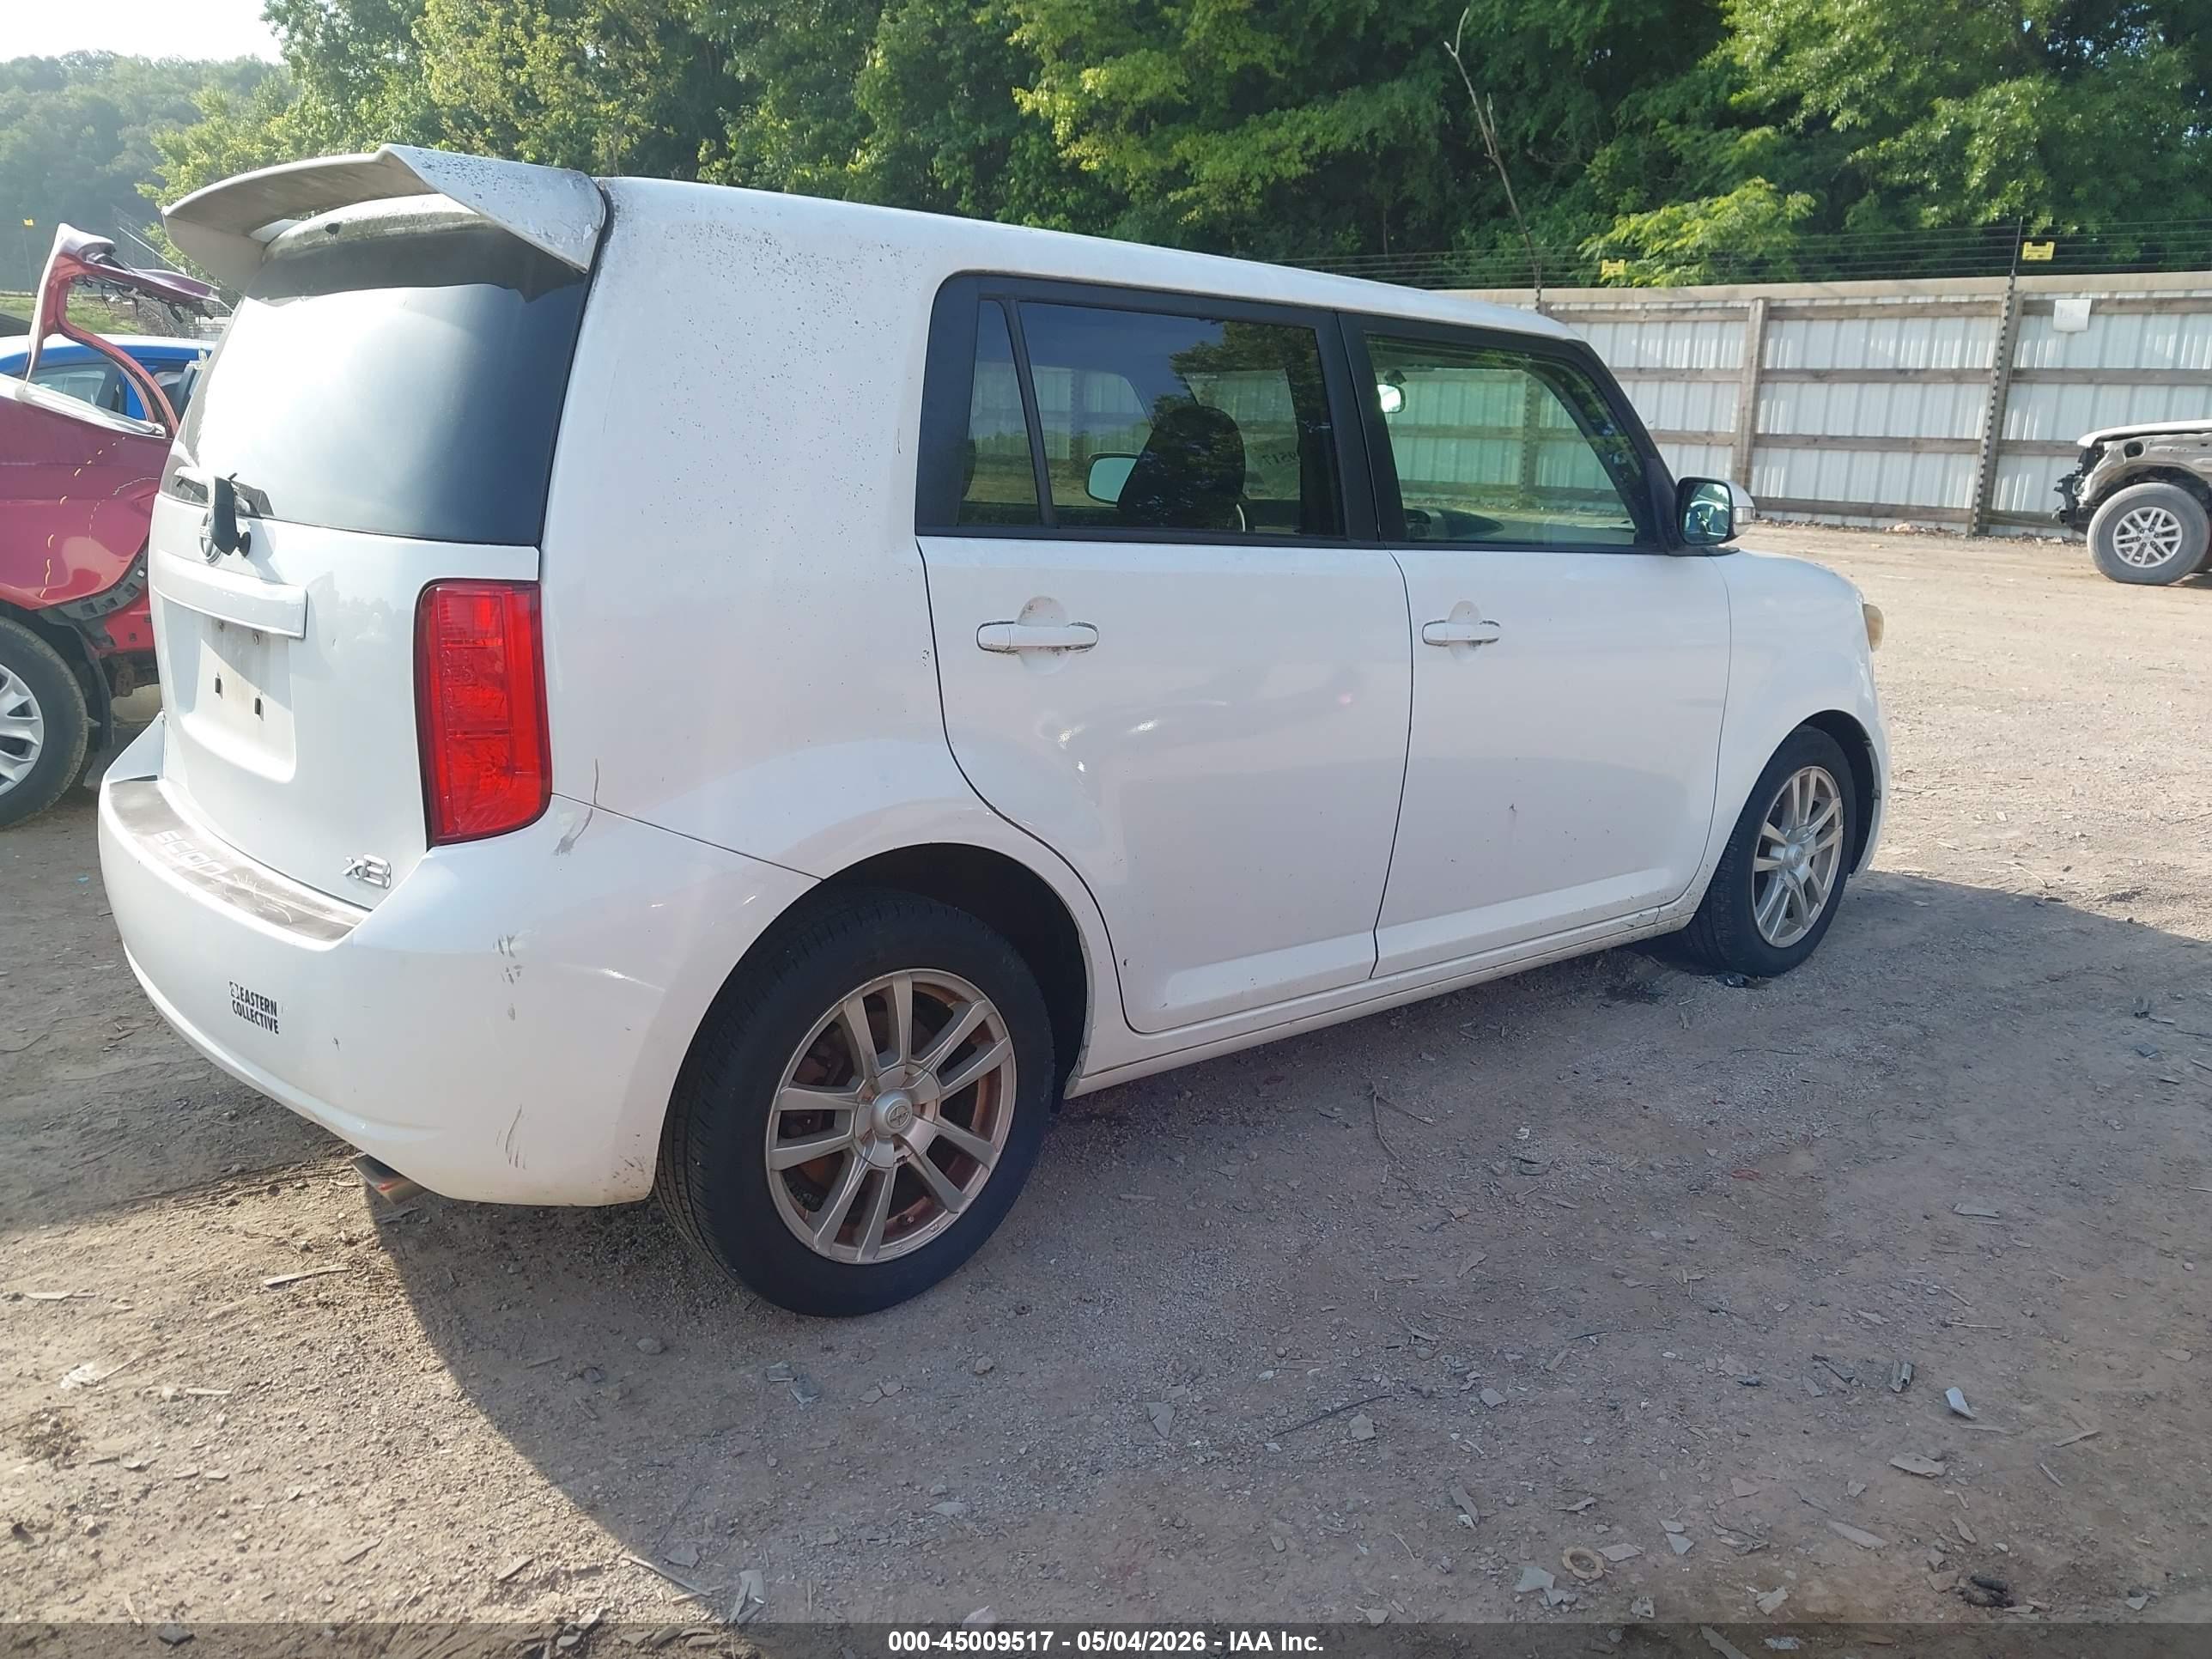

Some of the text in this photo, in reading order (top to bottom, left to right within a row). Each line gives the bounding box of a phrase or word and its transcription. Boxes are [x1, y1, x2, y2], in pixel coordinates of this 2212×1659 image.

[341, 854, 392, 890] xB
[232, 999, 279, 1035] COLLECTIVE
[240, 986, 277, 1018] EASTERN
